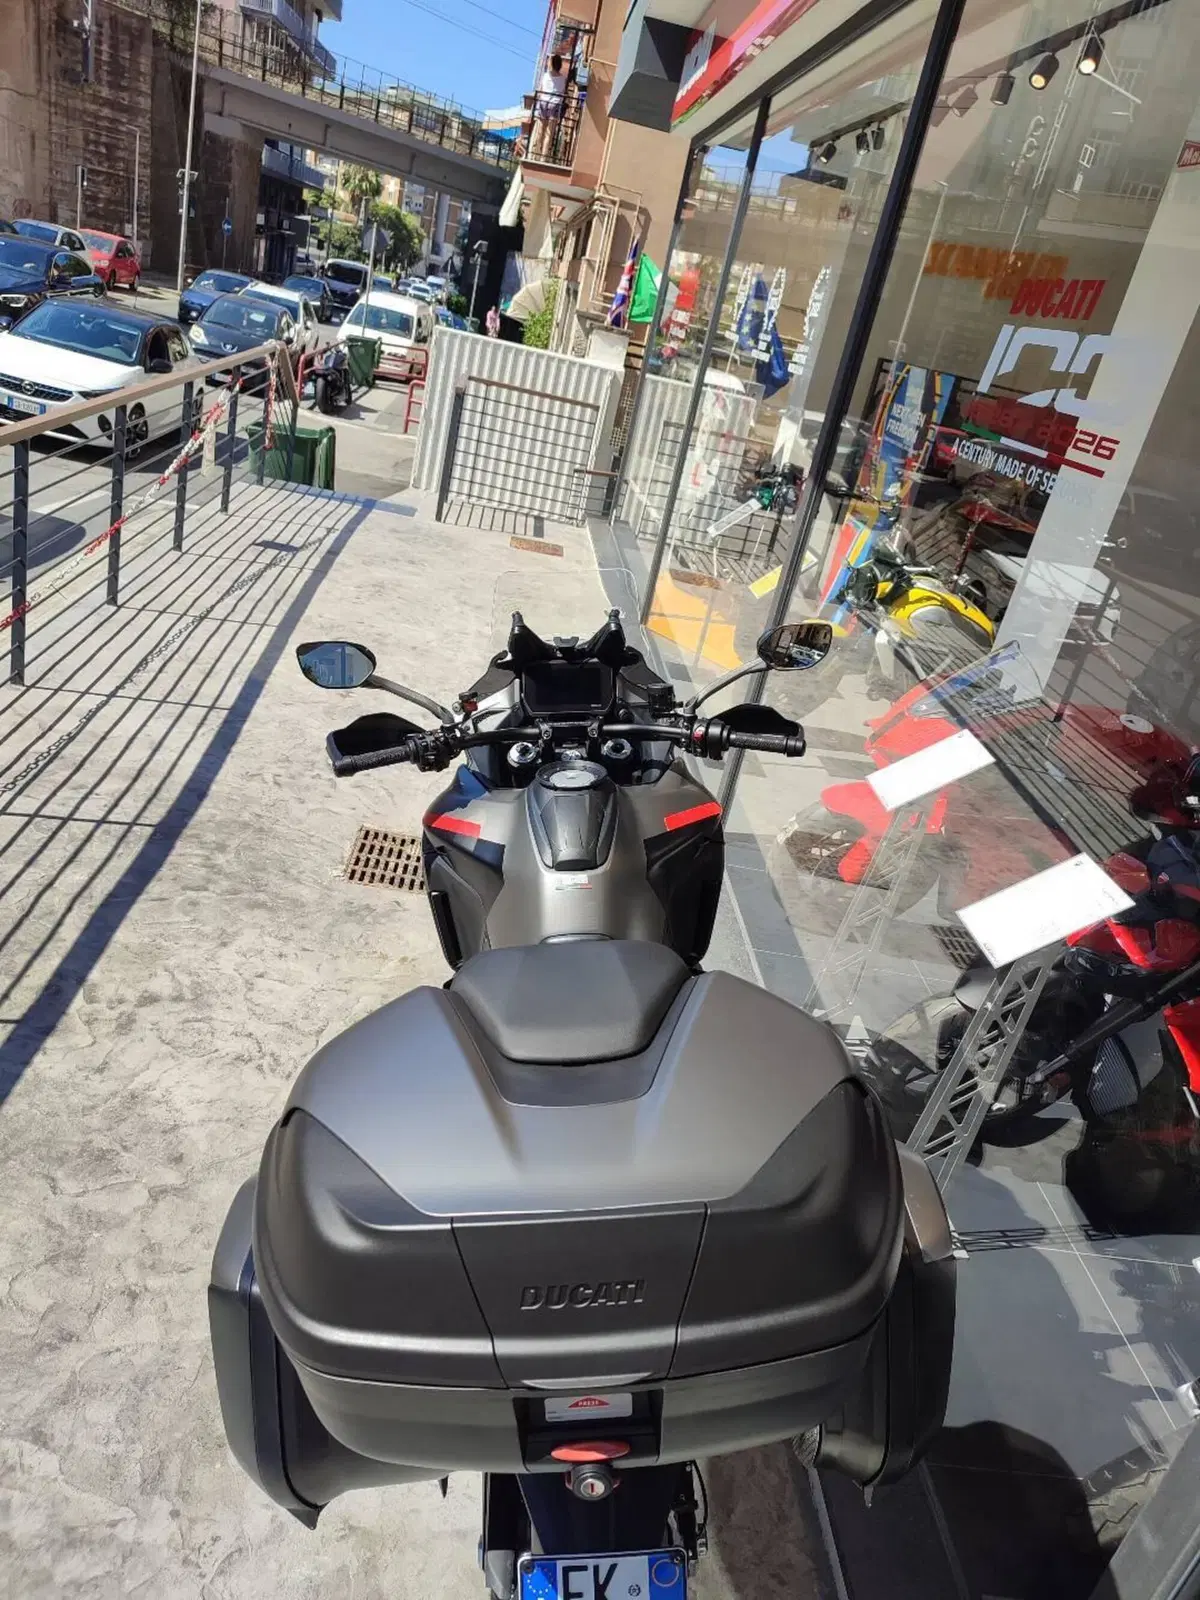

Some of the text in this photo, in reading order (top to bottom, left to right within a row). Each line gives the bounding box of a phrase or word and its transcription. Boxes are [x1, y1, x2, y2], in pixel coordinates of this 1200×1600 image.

[1009, 279, 1107, 321] DUCATI
[952, 437, 1042, 488] A CENTURY MADE OF
[520, 1278, 646, 1310] DUCATI
